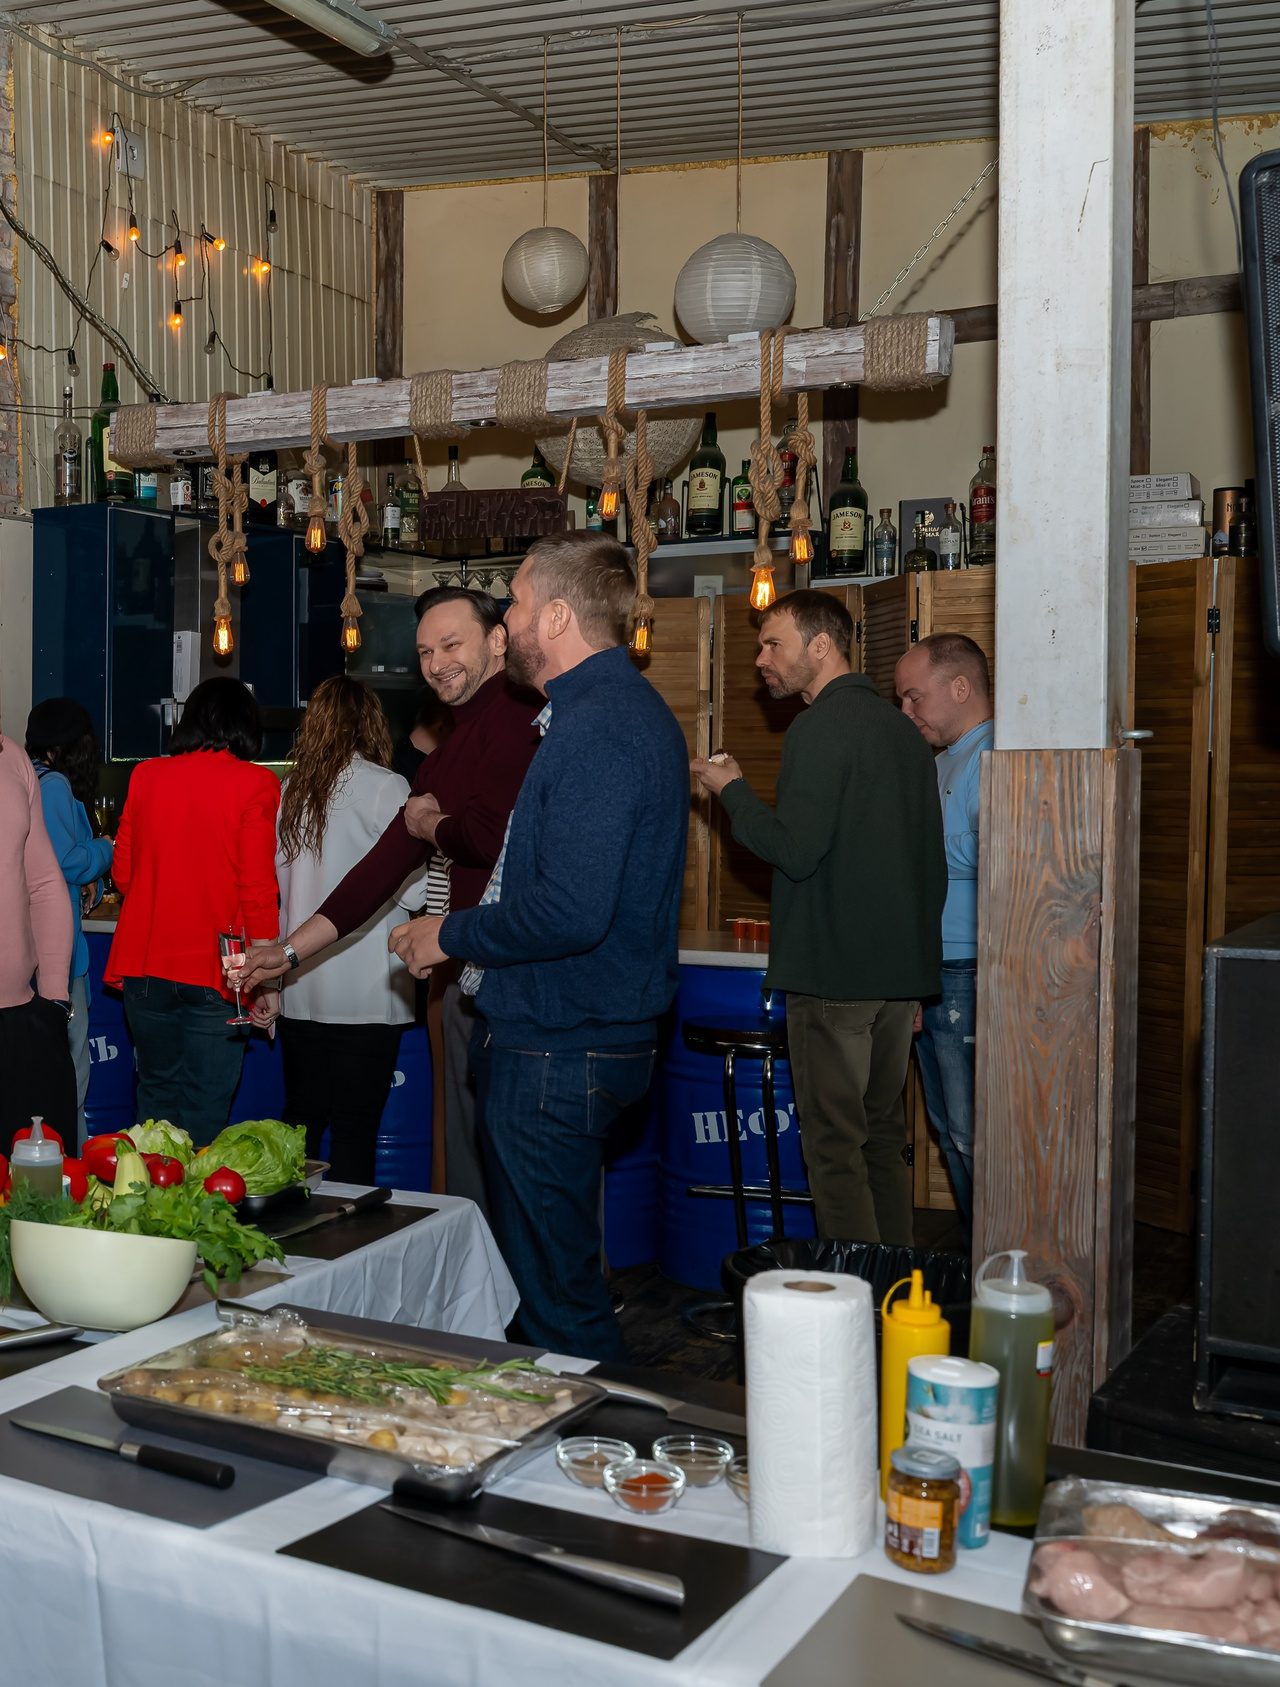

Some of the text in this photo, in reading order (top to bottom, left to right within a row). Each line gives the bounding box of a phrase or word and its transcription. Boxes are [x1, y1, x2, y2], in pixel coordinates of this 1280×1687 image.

[690, 471, 718, 481] JAMESON
[832, 510, 863, 521] JAMESON
[692, 1103, 800, 1143] НЕФ
[934, 1429, 962, 1443] SALT
